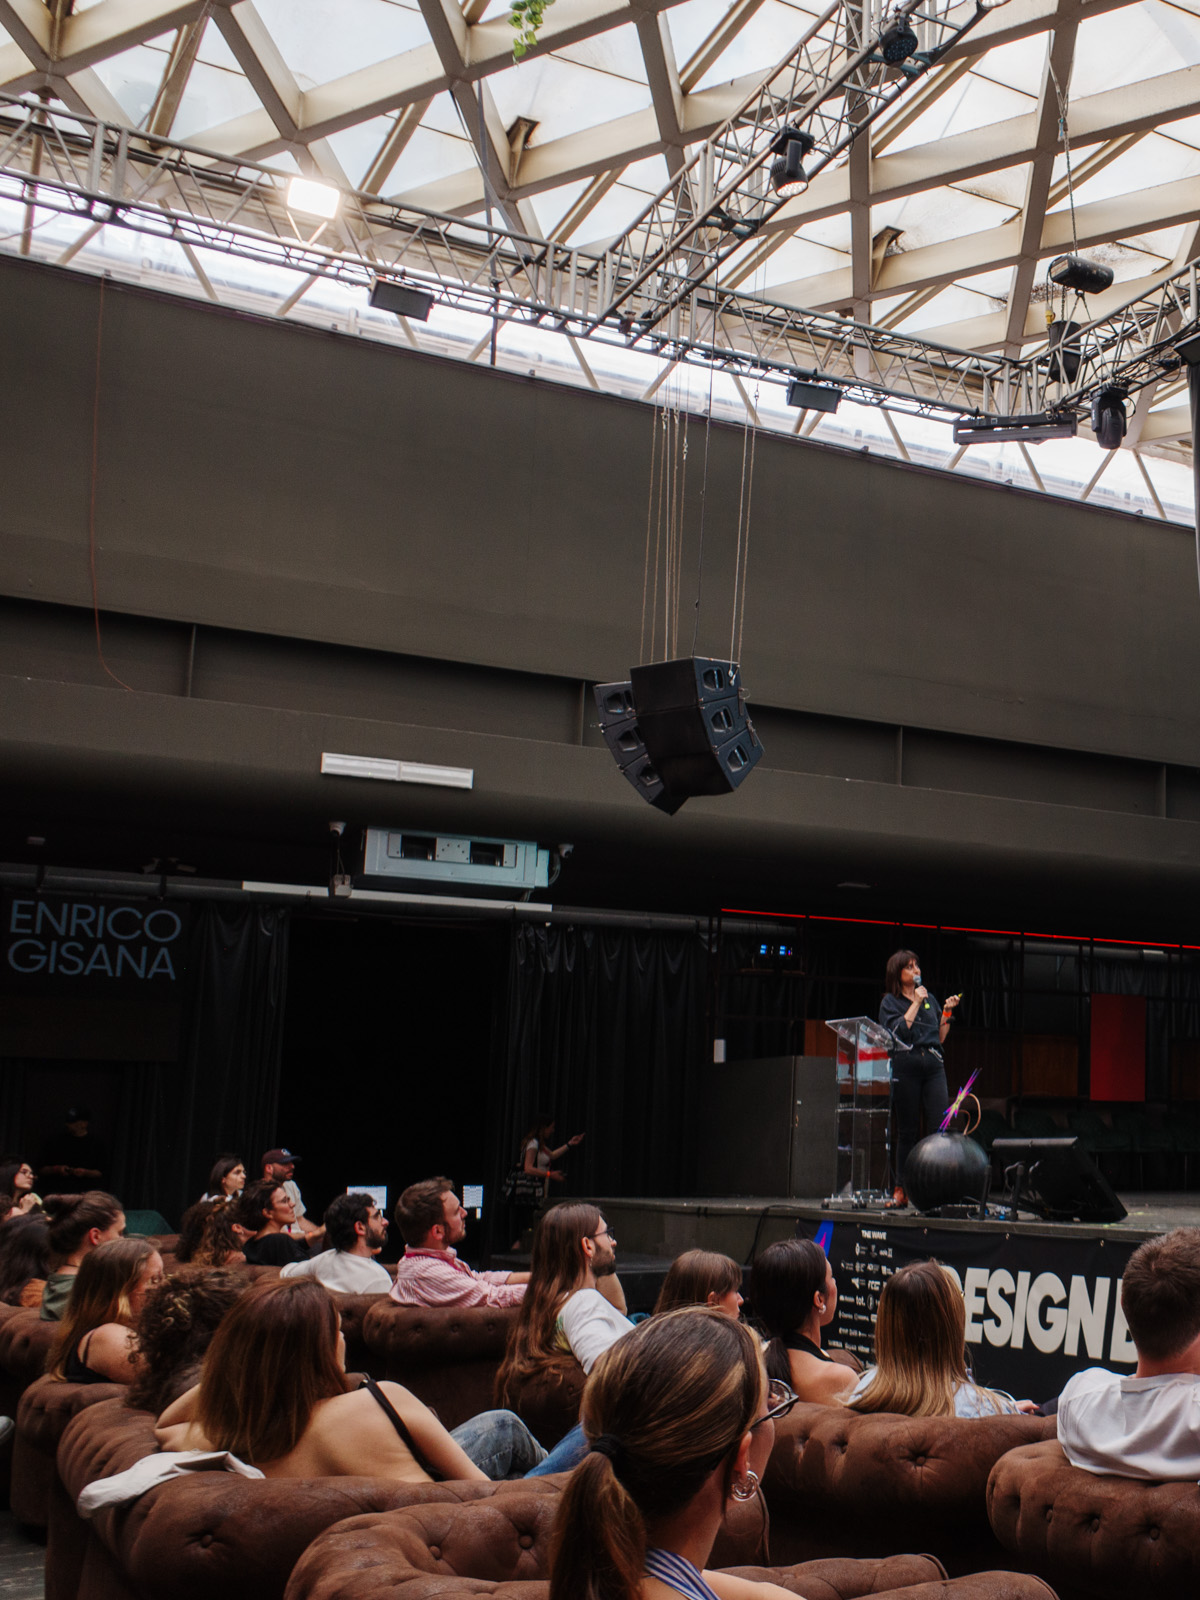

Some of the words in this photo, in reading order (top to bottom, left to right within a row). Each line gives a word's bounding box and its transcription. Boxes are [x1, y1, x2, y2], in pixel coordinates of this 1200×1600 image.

[9, 899, 182, 943] ENRICO
[7, 938, 176, 981] GISANA
[940, 1264, 1110, 1361] ESIGN
